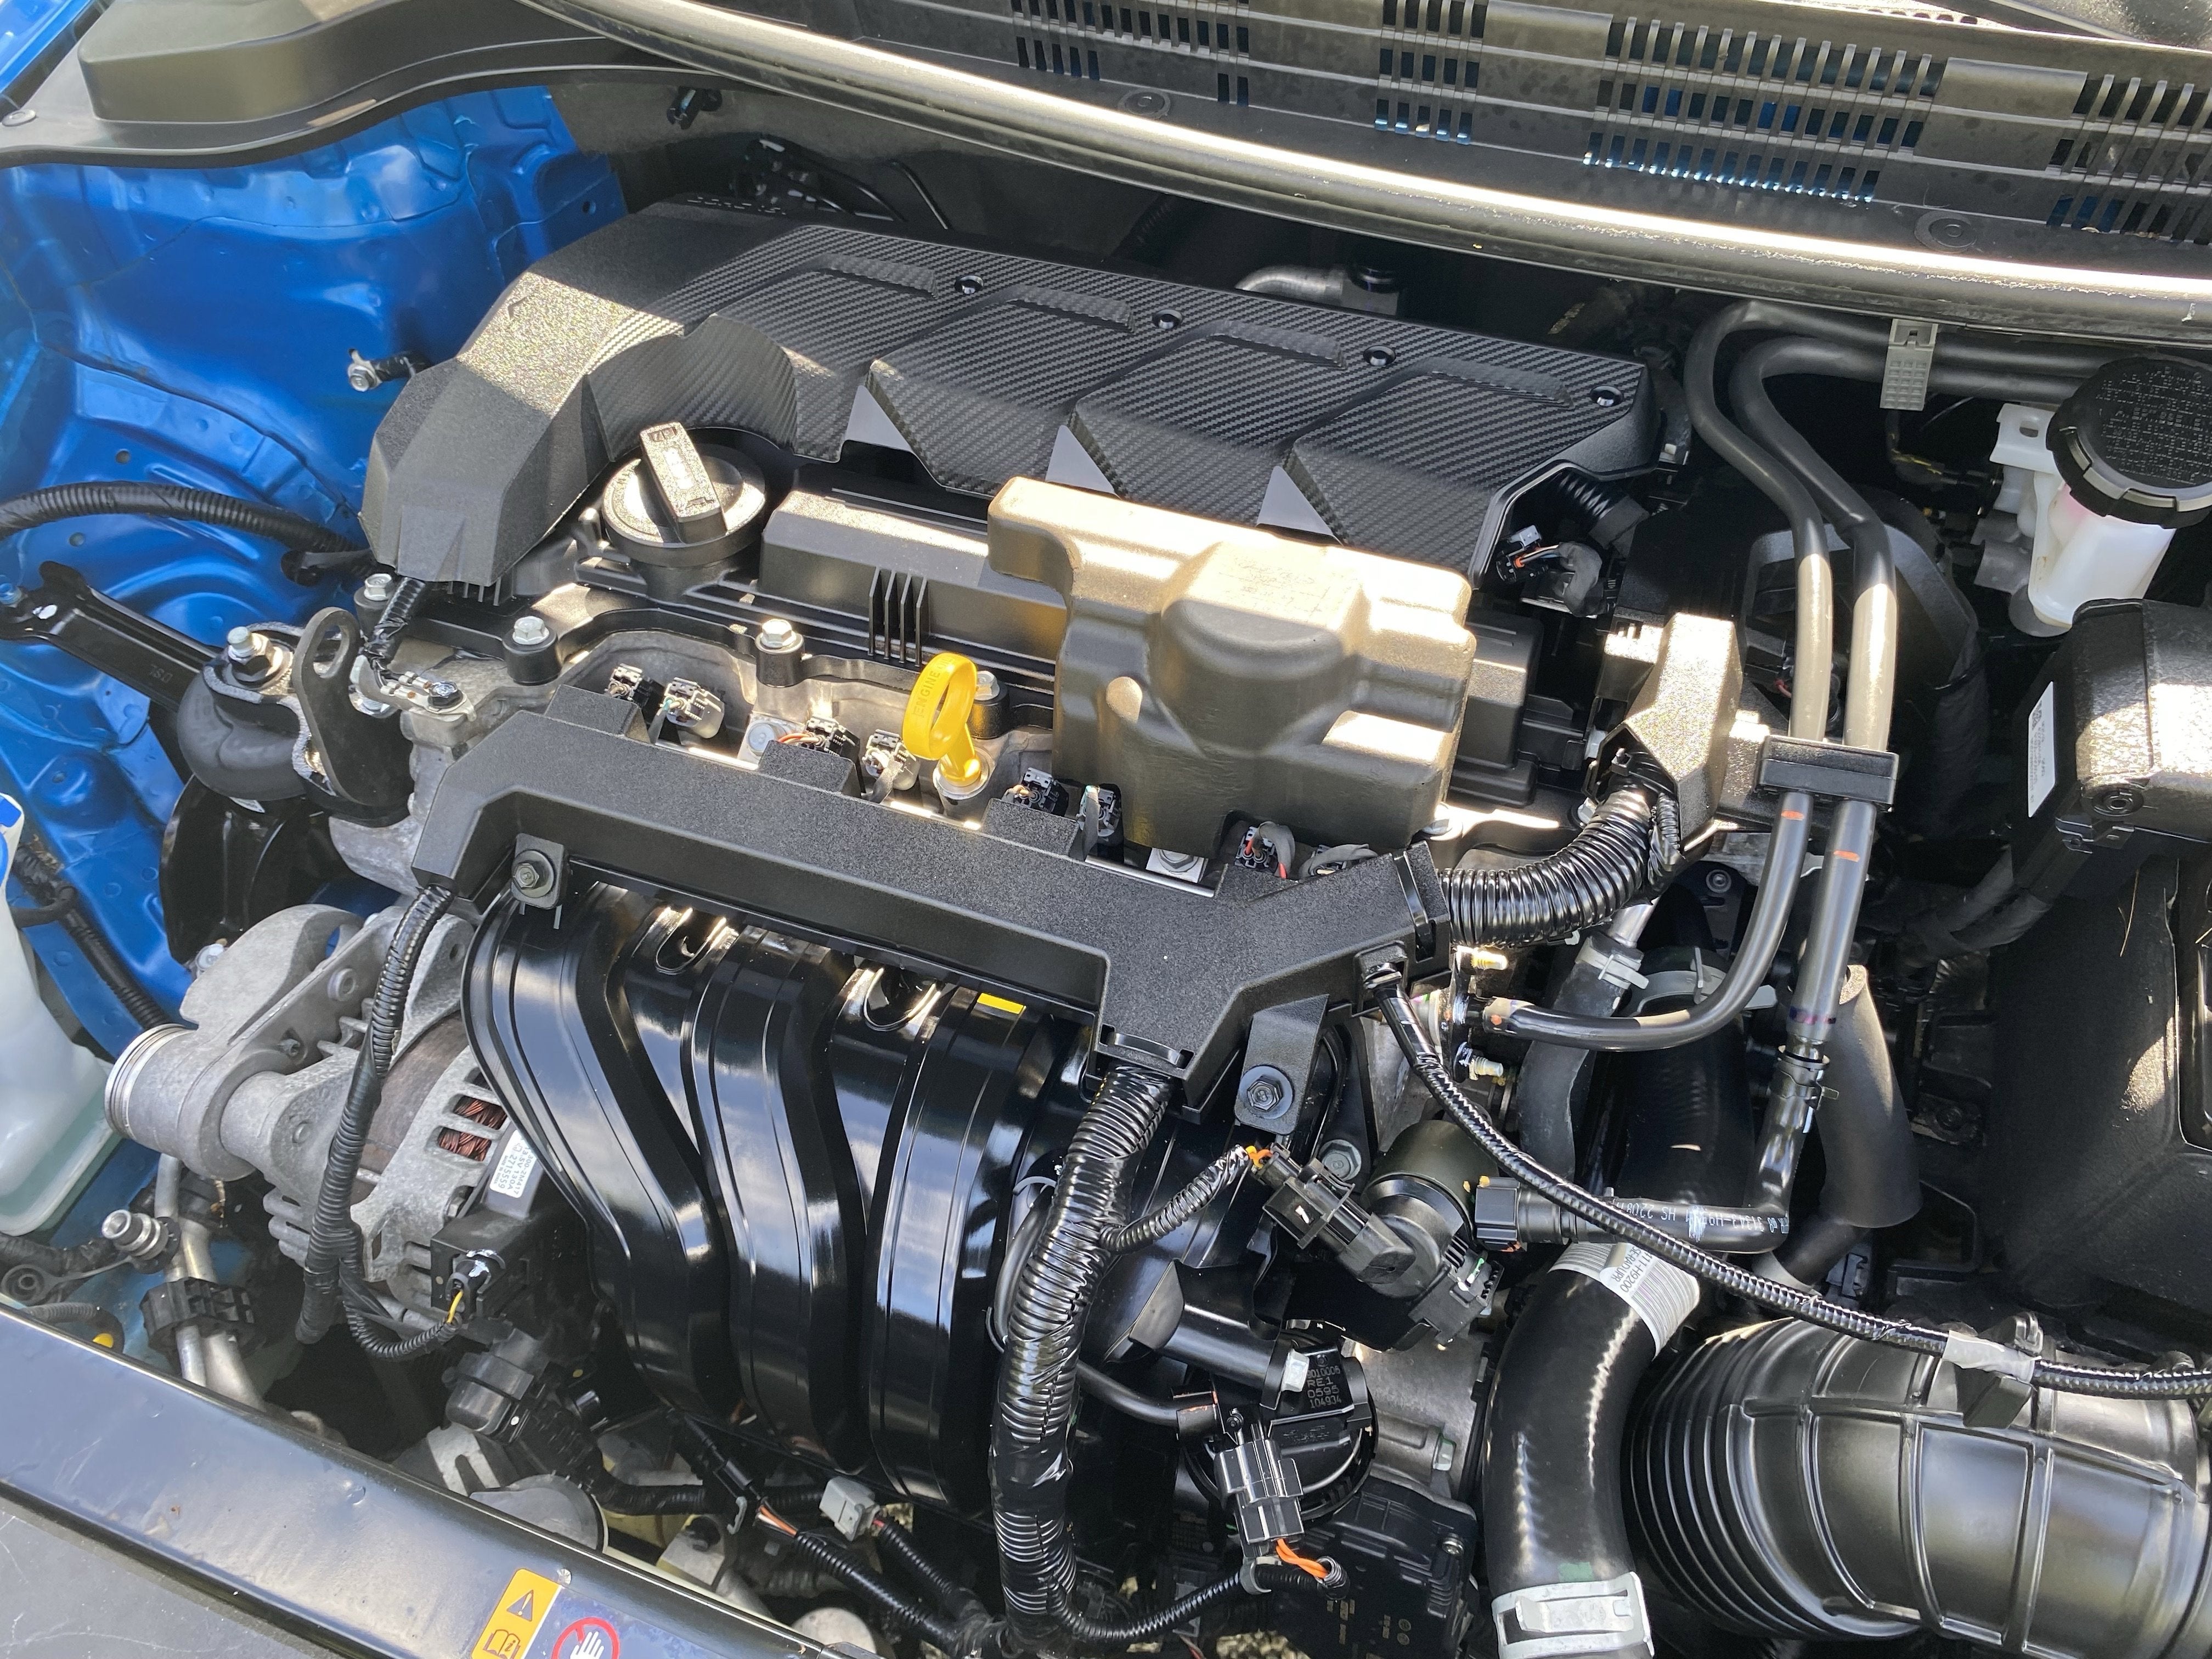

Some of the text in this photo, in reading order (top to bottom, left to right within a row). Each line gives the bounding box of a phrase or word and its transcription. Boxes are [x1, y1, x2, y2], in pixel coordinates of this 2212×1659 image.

[912, 670, 940, 717] ENGINE
[498, 1154, 517, 1189] 2715559
[507, 1170, 519, 1189] 130A
[514, 1154, 534, 1194] 300-2M417
[1661, 1206, 1676, 1221] HS
[1610, 1267, 1626, 1283] UPR
[1307, 1378, 1334, 1388] RE1
